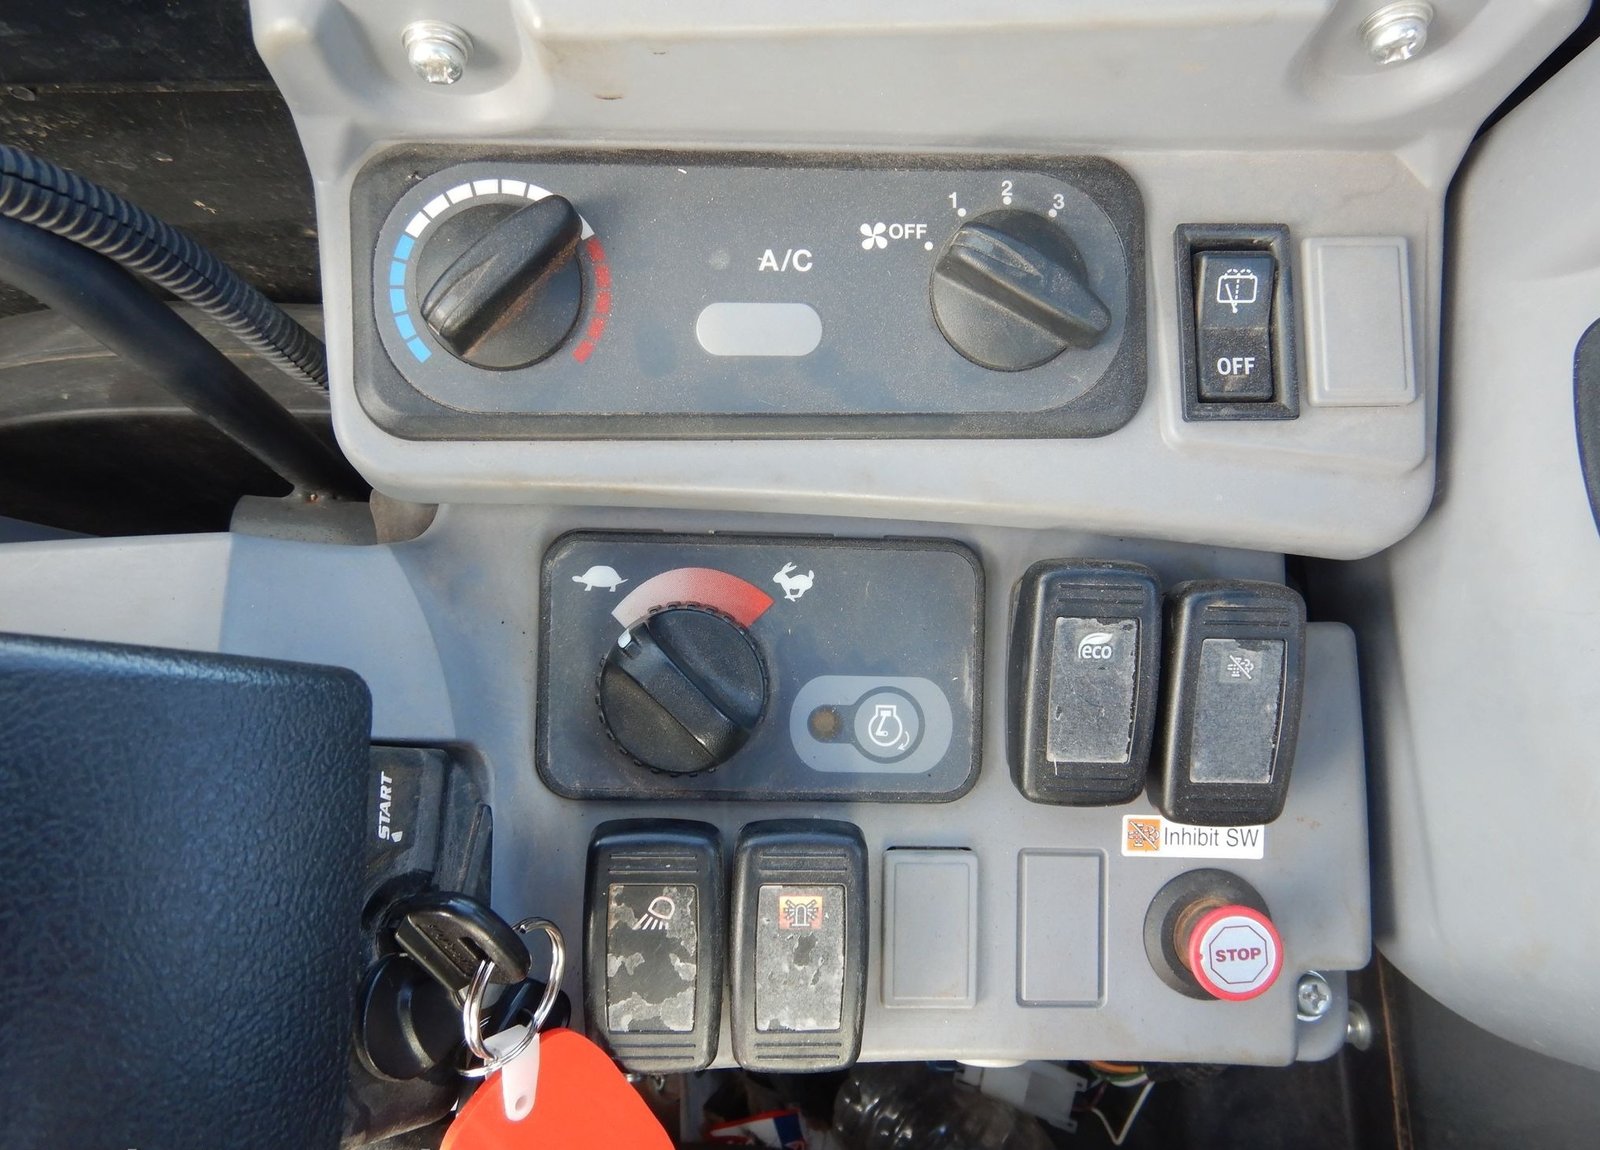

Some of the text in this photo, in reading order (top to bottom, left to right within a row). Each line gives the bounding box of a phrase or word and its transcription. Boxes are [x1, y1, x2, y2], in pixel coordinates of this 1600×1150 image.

[1001, 181, 1013, 196] 2
[949, 193, 958, 208] 1
[1053, 194, 1065, 209] 3
[888, 223, 927, 239] OFF
[758, 249, 812, 272] A/C
[1217, 357, 1255, 375] OFF
[1082, 645, 1112, 659] eco
[378, 771, 393, 840] START
[1165, 827, 1259, 847] Inhibit SW
[1215, 948, 1261, 962] STOP
